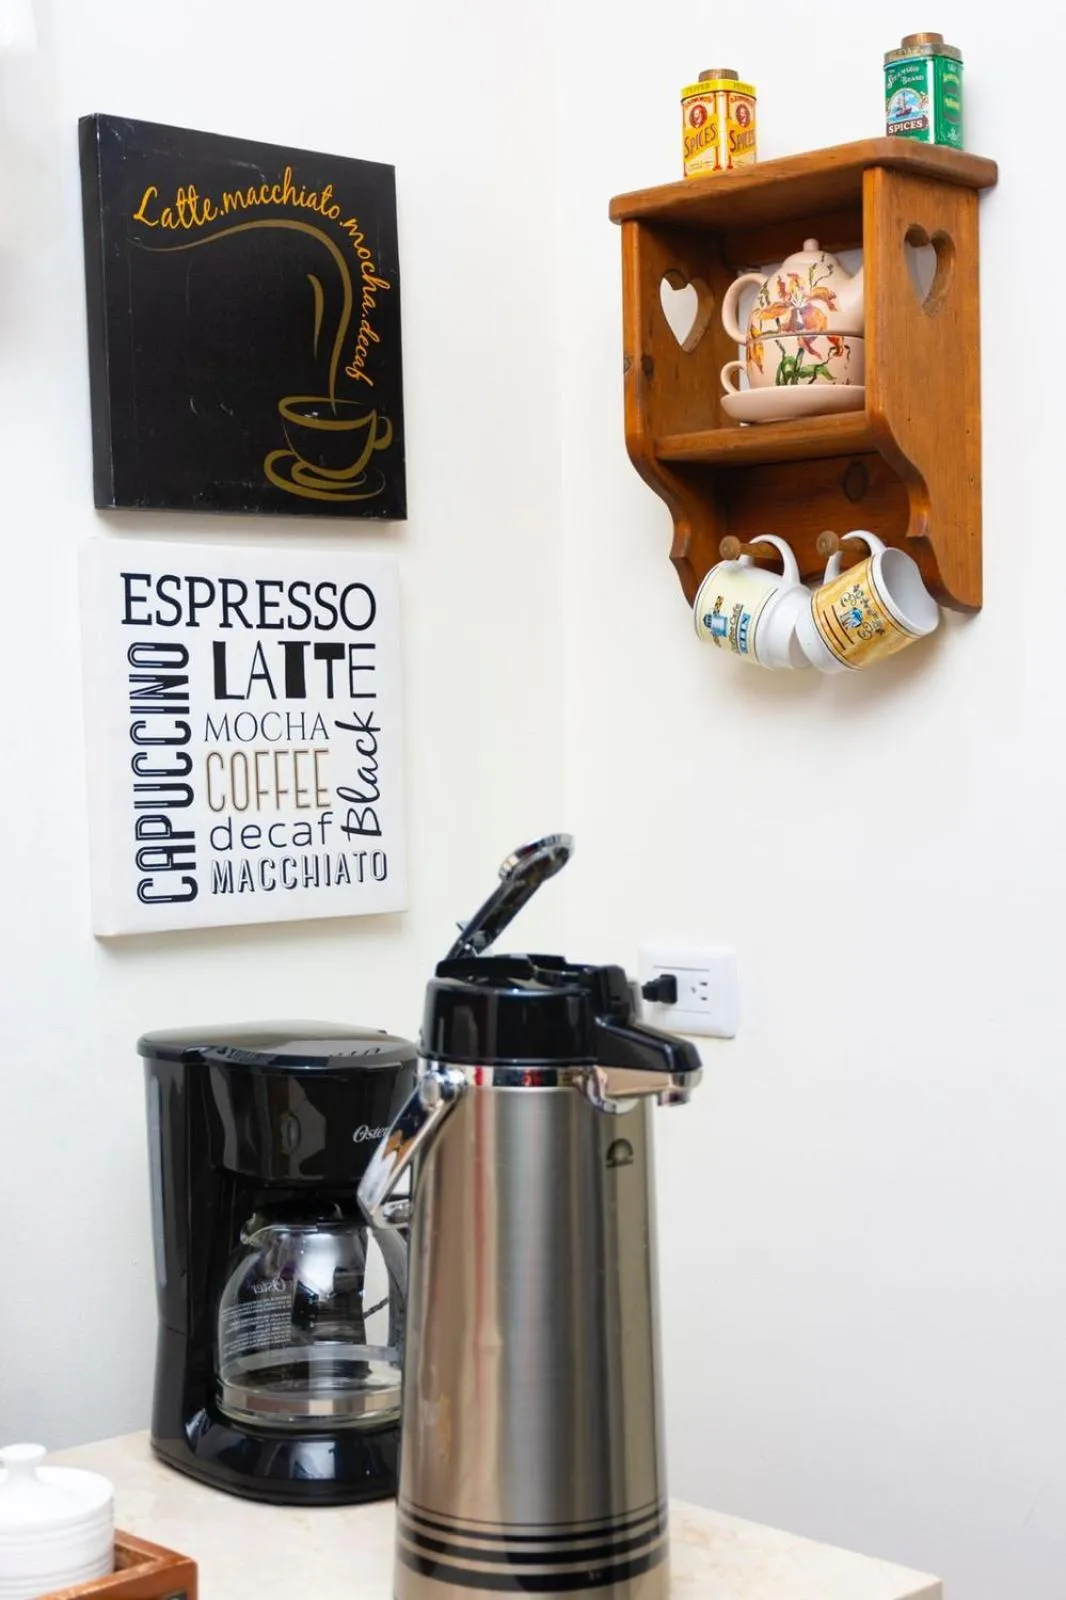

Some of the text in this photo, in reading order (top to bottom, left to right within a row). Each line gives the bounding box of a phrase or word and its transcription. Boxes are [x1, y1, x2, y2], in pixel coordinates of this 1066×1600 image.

[684, 122, 717, 159] SPICES
[888, 120, 923, 134] SPICES
[119, 572, 377, 632] ESPRESSO
[211, 640, 378, 701] LATTE
[204, 711, 331, 742] MOCHA
[126, 641, 199, 905] CAPUCCINO
[205, 748, 332, 813] COFFEE
[334, 710, 382, 842] Black
[209, 811, 335, 851] decaf
[210, 848, 388, 895] MACCHIATO
